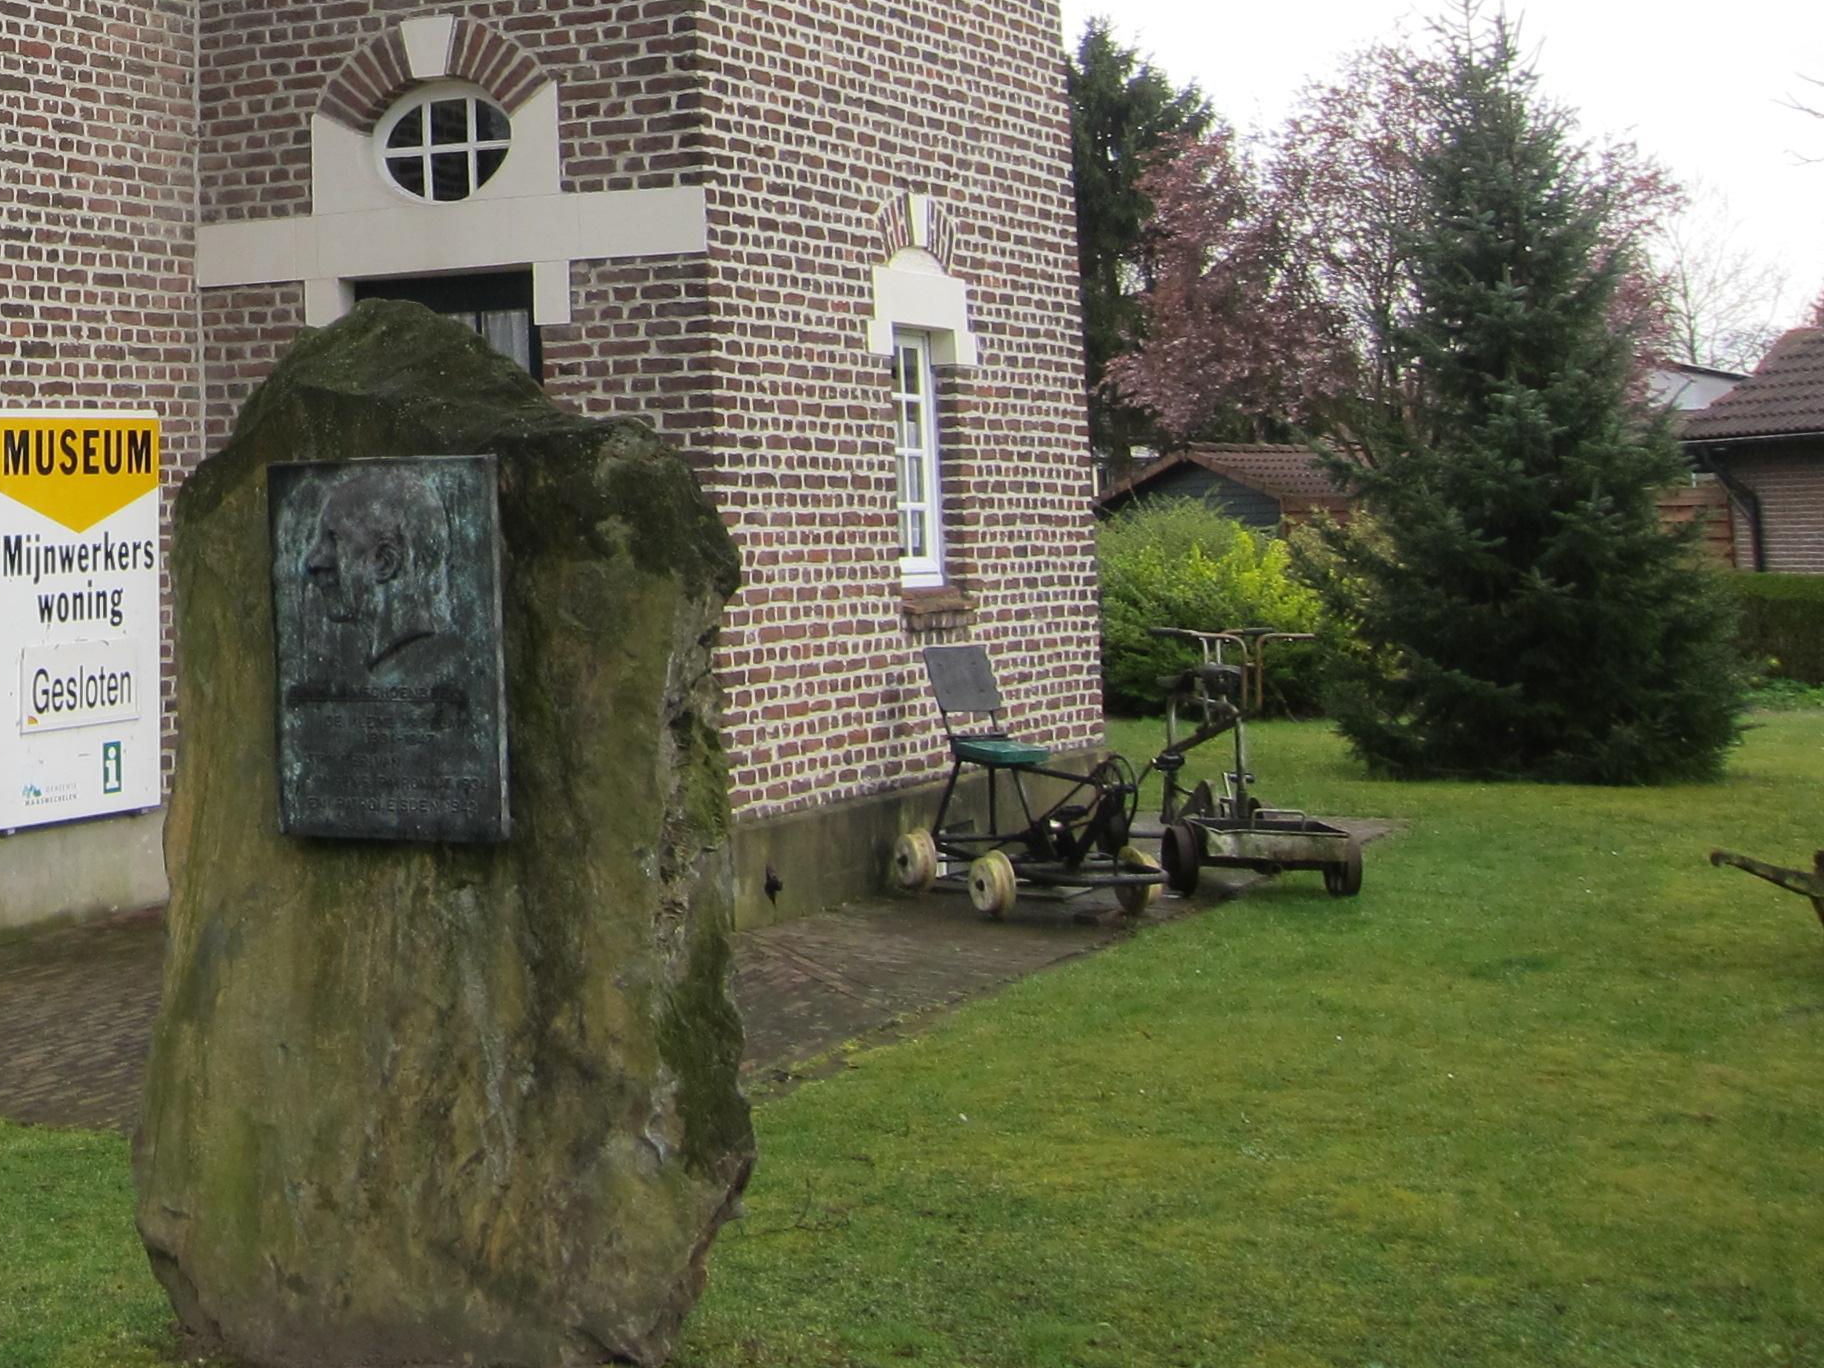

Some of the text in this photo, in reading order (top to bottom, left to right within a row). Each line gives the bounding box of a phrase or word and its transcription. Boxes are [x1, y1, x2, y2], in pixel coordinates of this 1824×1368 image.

[3, 429, 152, 476] MUSEUM
[3, 531, 155, 585] Mijnwerkers
[38, 580, 124, 627] woning
[33, 665, 131, 714] Gesloten
